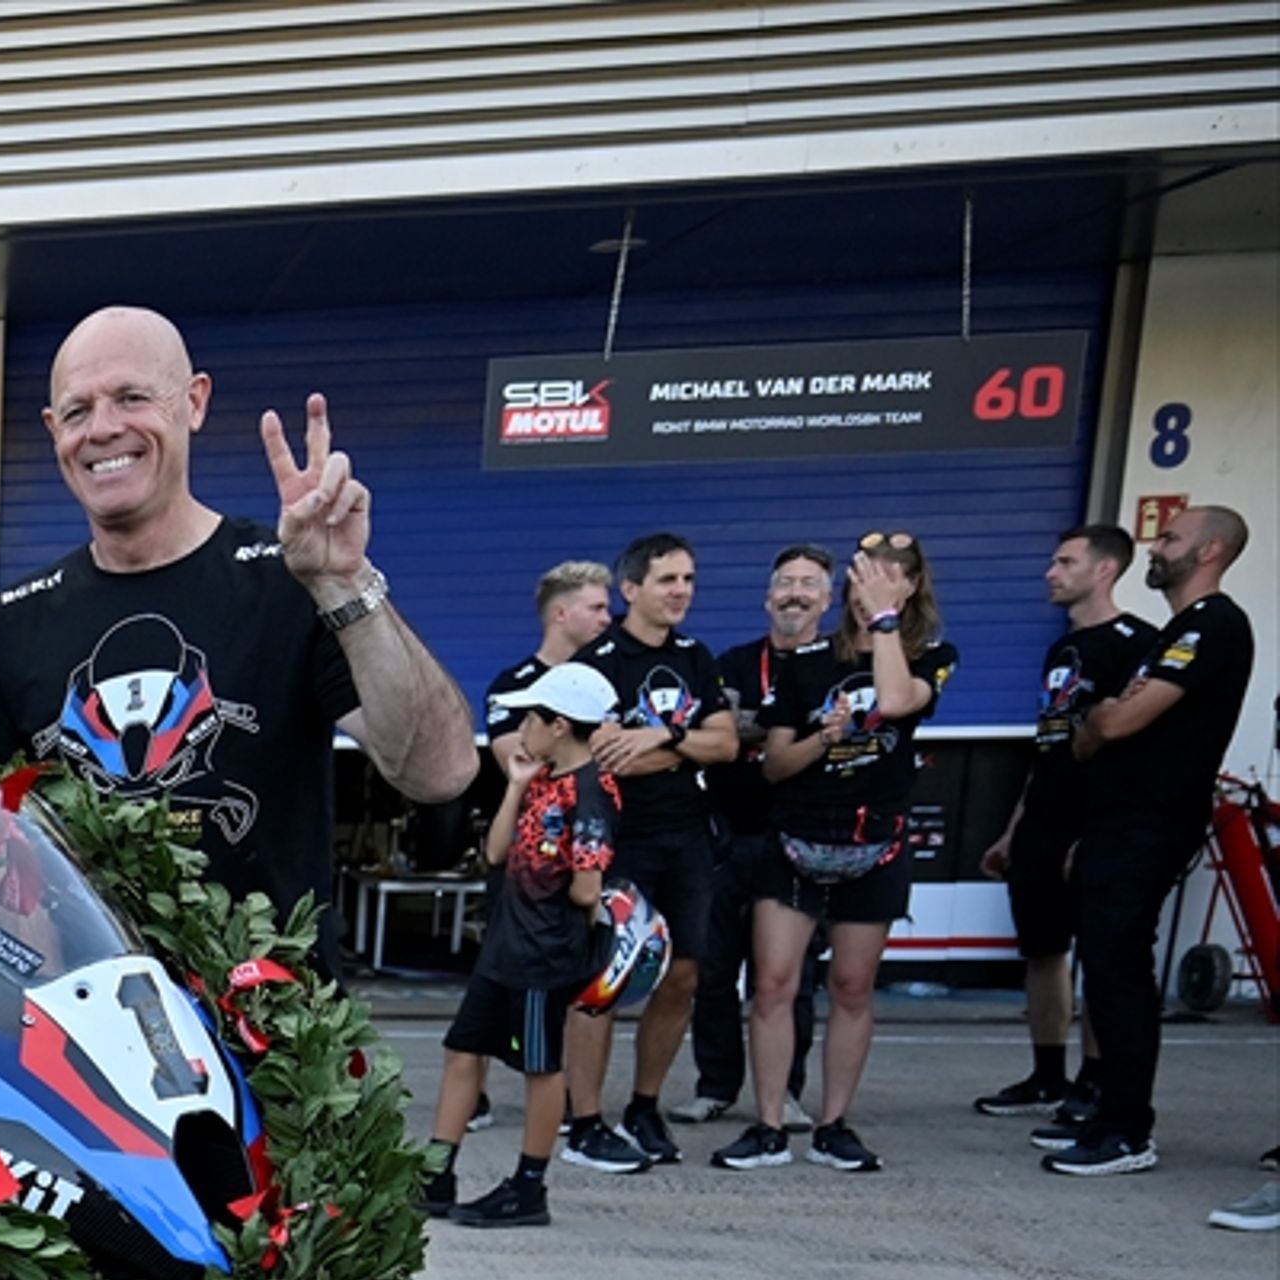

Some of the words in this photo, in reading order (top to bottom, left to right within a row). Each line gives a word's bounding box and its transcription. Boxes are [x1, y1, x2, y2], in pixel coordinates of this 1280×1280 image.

[502, 376, 612, 408] SBK
[649, 379, 750, 401] MICHAEL
[756, 376, 804, 396] VAN
[808, 374, 856, 394] DER
[861, 370, 932, 392] MARK
[972, 364, 1065, 420] 60
[505, 409, 605, 434] MOTUL
[885, 411, 922, 424] TEAM
[1149, 402, 1192, 469] 8
[116, 971, 210, 1101] 1
